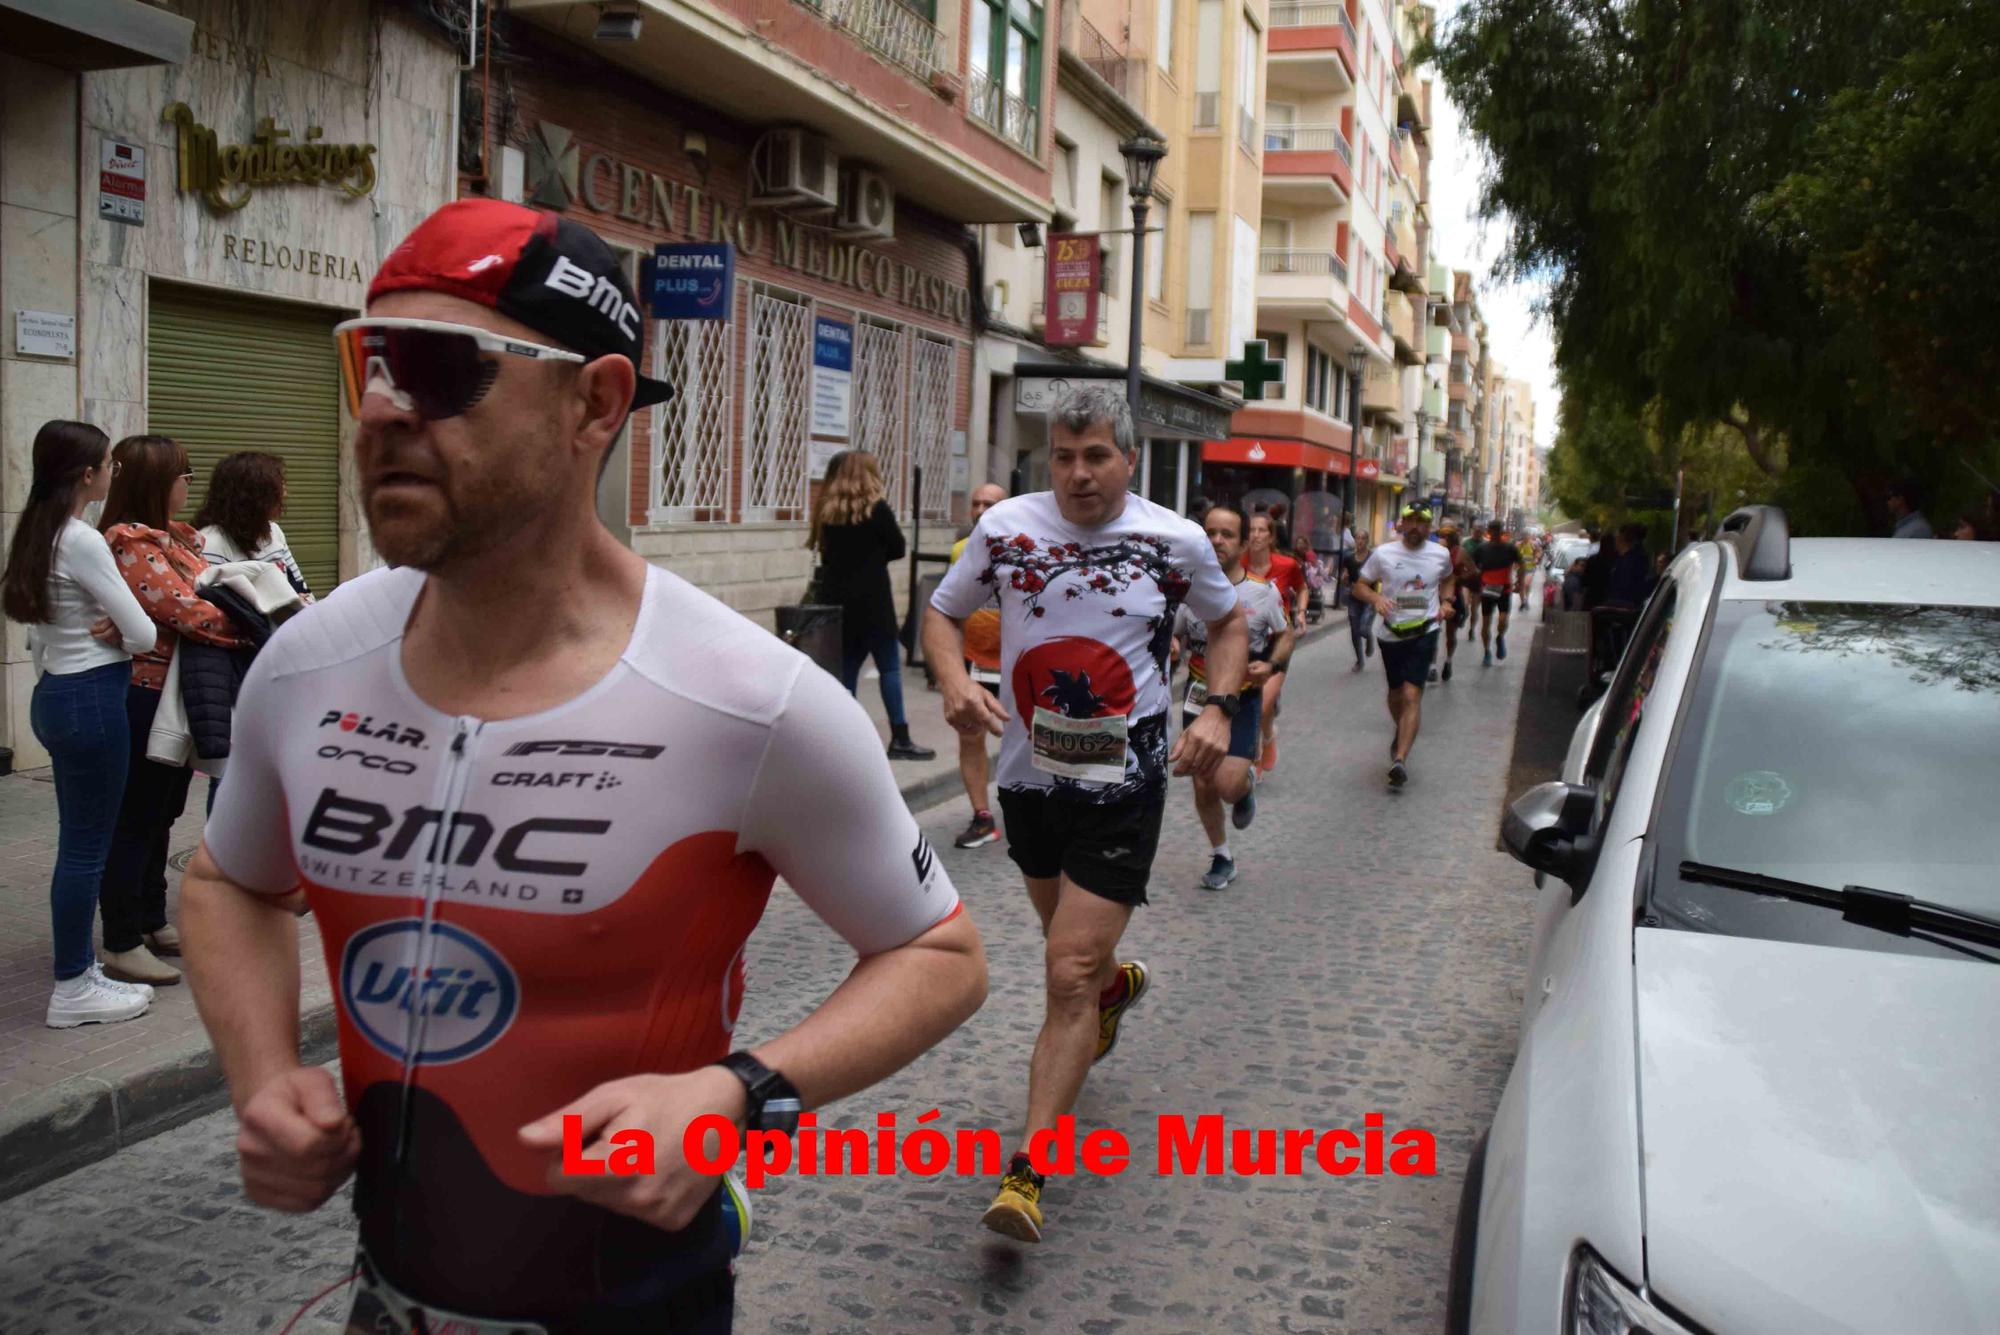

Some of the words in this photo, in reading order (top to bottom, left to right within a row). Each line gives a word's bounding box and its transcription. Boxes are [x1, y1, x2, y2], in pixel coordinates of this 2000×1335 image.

[162, 102, 377, 212] Montesinos
[223, 234, 362, 283] RELOJERIA
[583, 153, 763, 256] CENTRO
[902, 264, 971, 325] PASEO
[657, 254, 724, 269] DENTAL
[544, 255, 640, 342] BMC
[818, 323, 851, 343] DENTAL
[319, 709, 429, 750] POLAR
[1042, 729, 1116, 753] 1062
[490, 771, 594, 788] CRAFT
[302, 786, 612, 877] BMC
